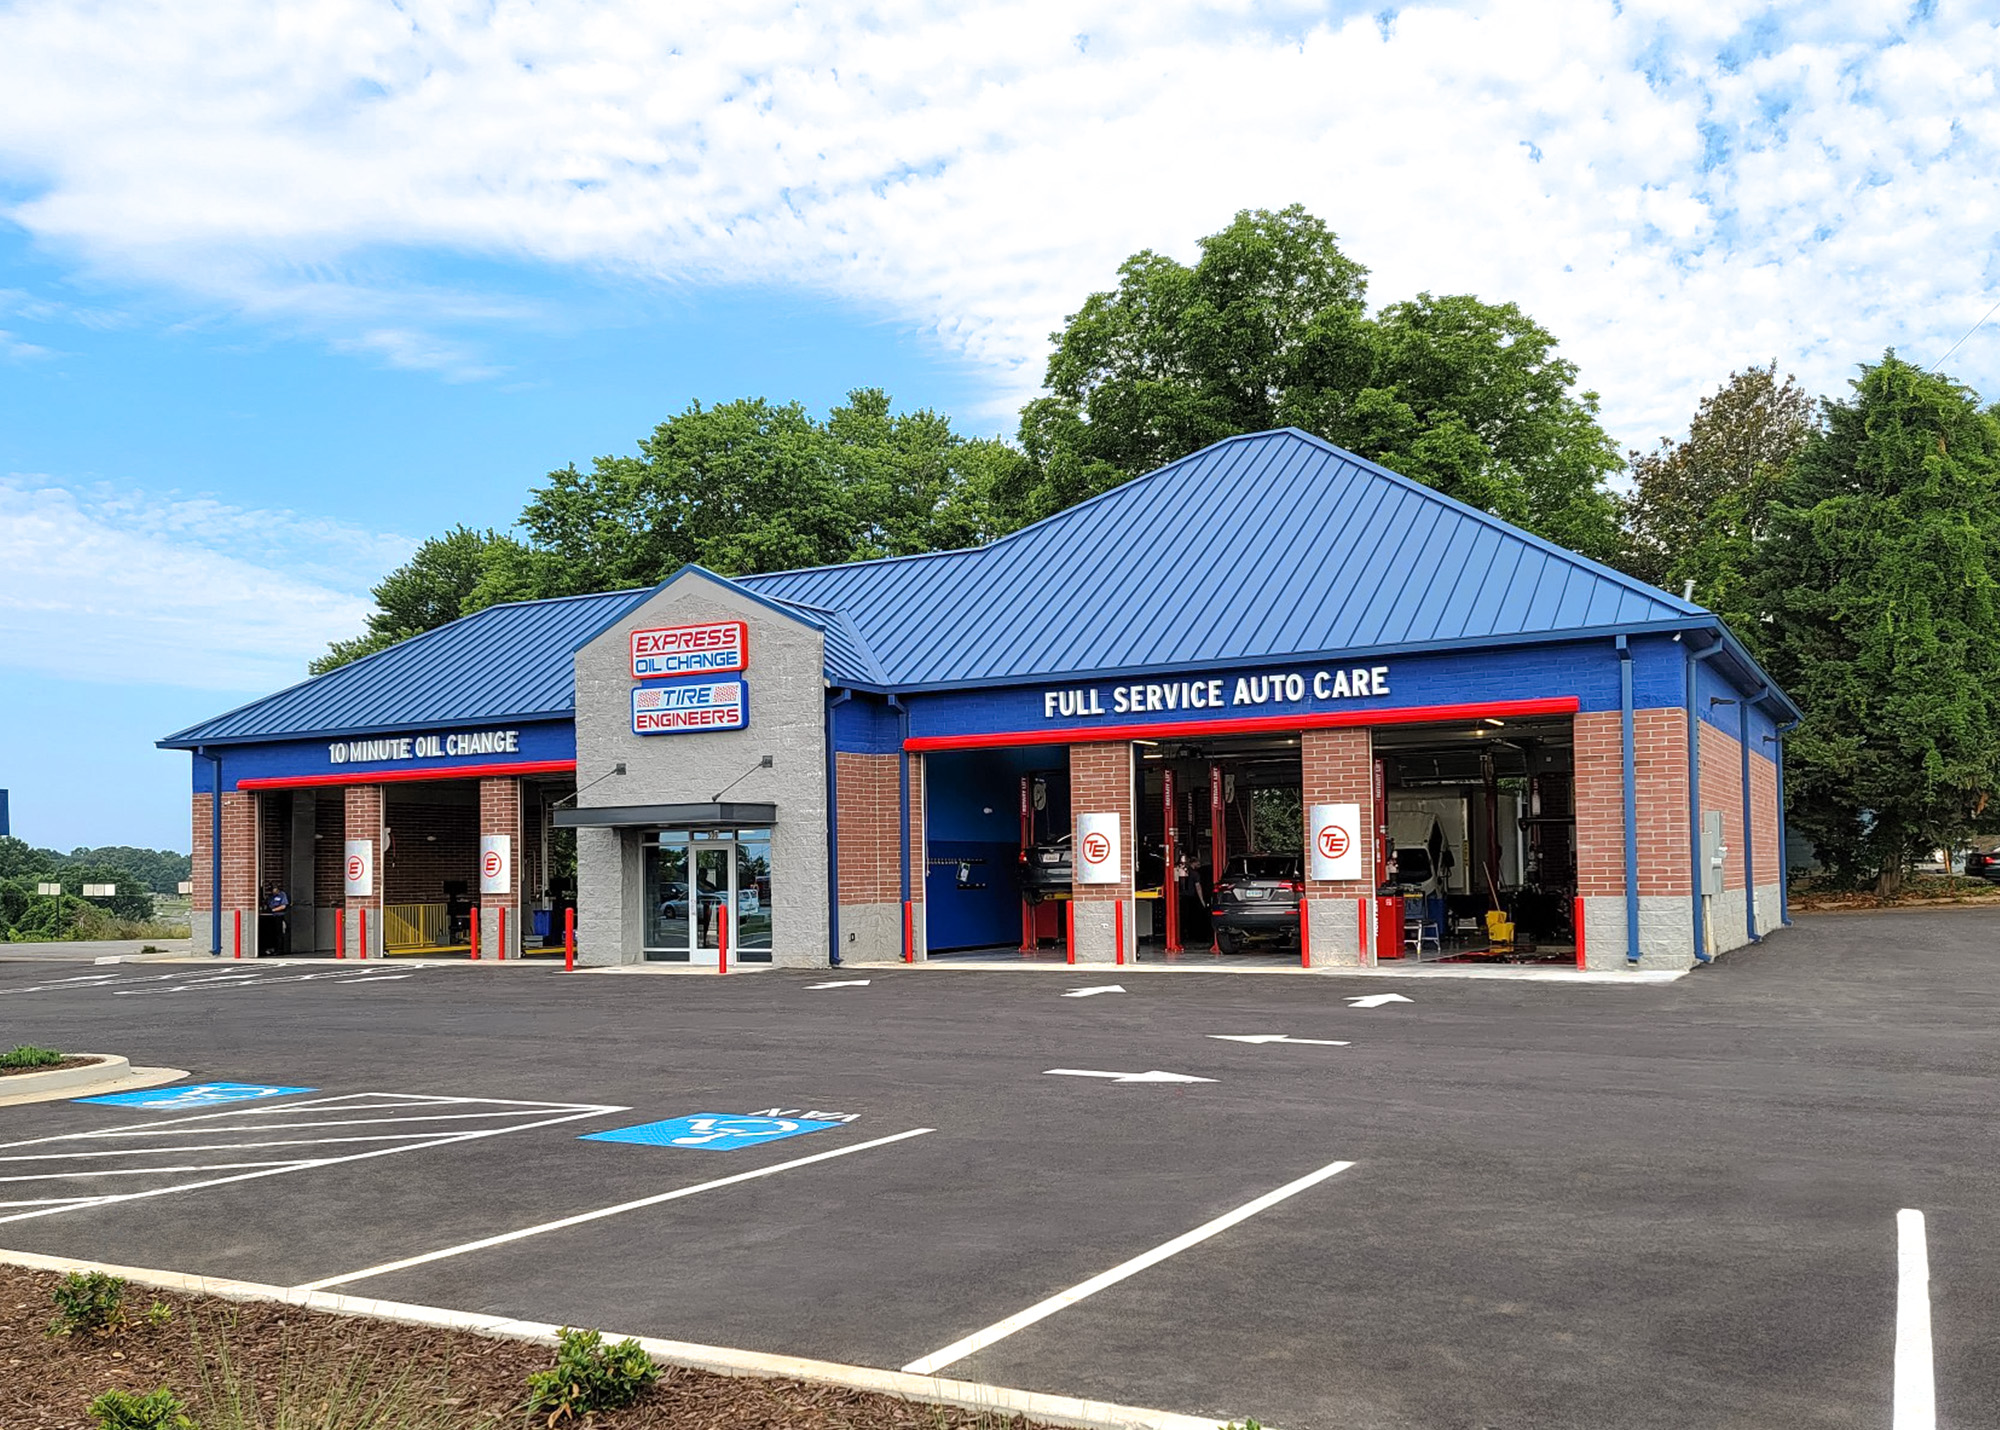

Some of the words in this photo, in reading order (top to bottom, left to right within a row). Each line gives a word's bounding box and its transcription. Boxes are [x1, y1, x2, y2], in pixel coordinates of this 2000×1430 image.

[635, 627, 738, 653] EXPRESS
[635, 658, 662, 674] OIL
[665, 651, 738, 671] CHANGE
[663, 687, 712, 706] TIRE
[1044, 688, 1106, 718] FULL
[1112, 679, 1225, 714] SERVICE
[1232, 673, 1305, 706] AUTO
[1312, 666, 1391, 700] CARE
[636, 708, 739, 730] ENGINEERS
[328, 742, 350, 764] 10
[350, 738, 414, 763] MINUTE
[415, 736, 446, 758] OIL
[446, 731, 519, 756] CHANGE
[1086, 840, 1107, 857] TE
[1322, 833, 1346, 852] TE
[349, 862, 360, 874] E
[485, 858, 498, 871] E
